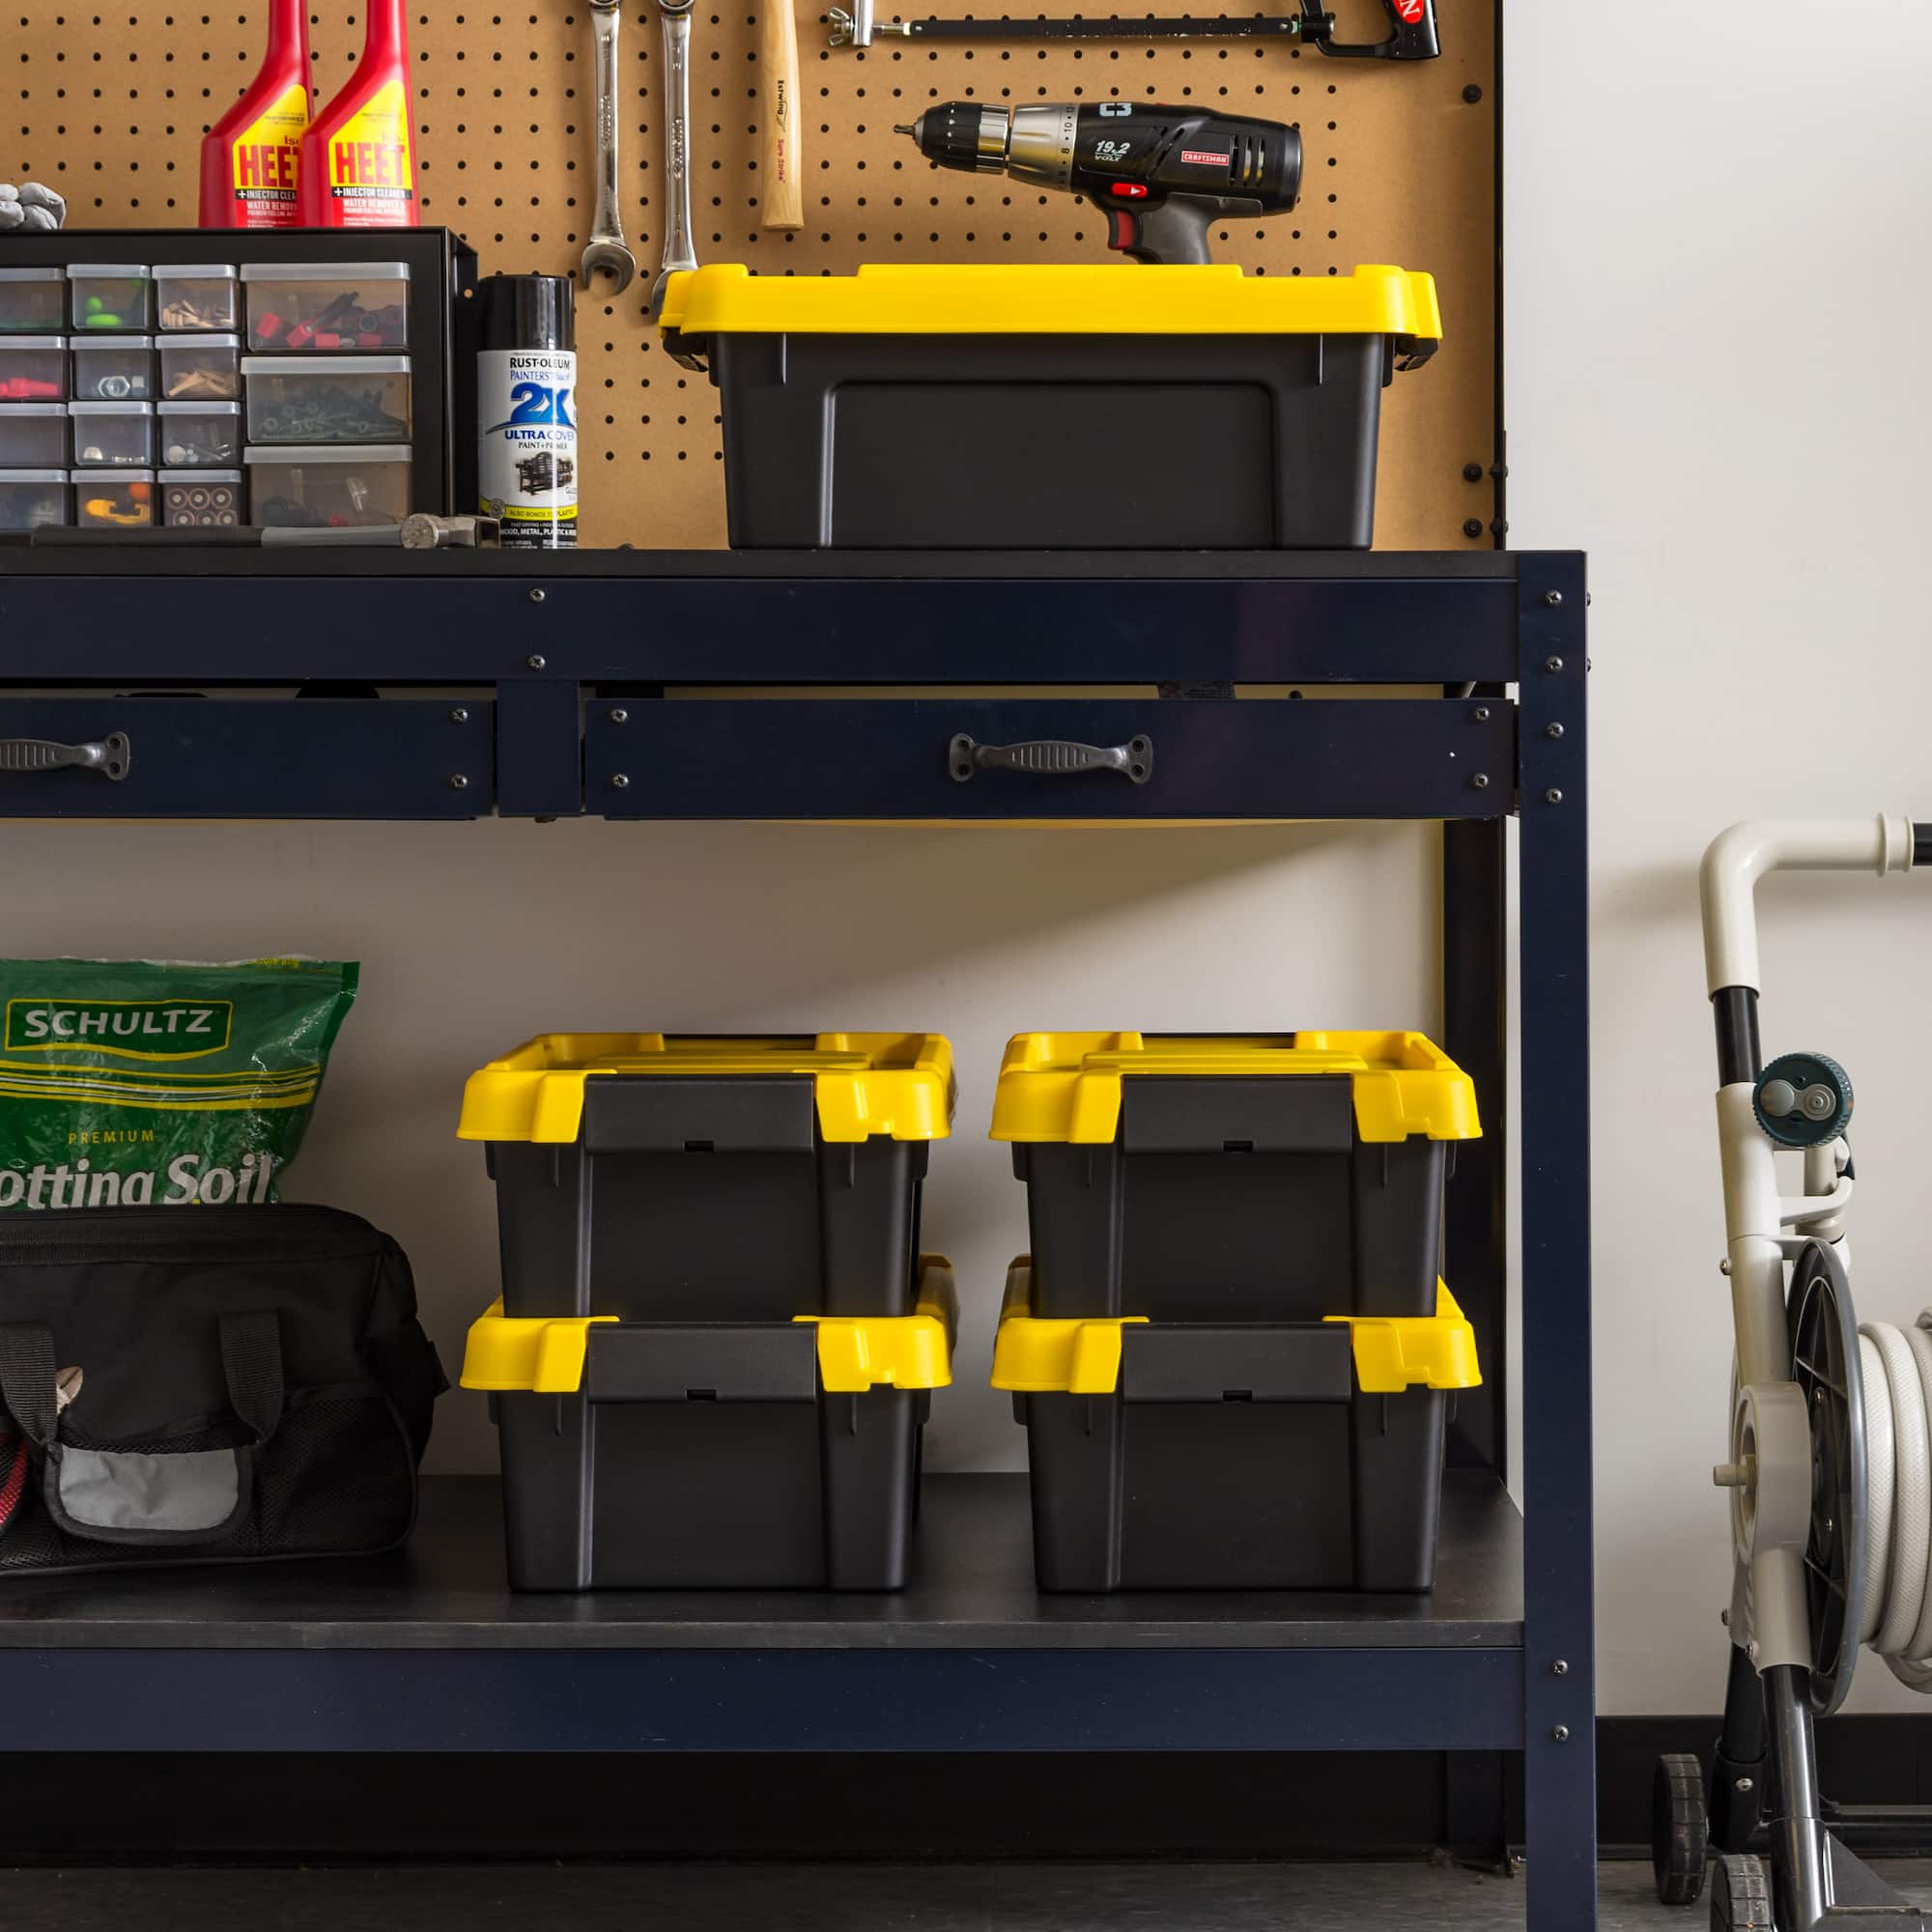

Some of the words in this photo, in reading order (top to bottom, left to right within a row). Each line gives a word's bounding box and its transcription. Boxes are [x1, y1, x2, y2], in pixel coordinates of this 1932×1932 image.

[776, 79, 785, 115] Estwing
[1064, 122, 1073, 132] 10
[1095, 140, 1131, 155] 19.2
[335, 142, 405, 186] HEET
[1183, 153, 1228, 163] CRAFTSMAN
[280, 190, 297, 200] CLEA
[246, 200, 270, 210] WATER
[510, 382, 570, 424] 2X
[504, 430, 546, 440] ULTRA
[23, 1009, 213, 1037] SCHULTZ
[68, 1129, 156, 1145] PREMIUM
[162, 1153, 273, 1207] Soil
